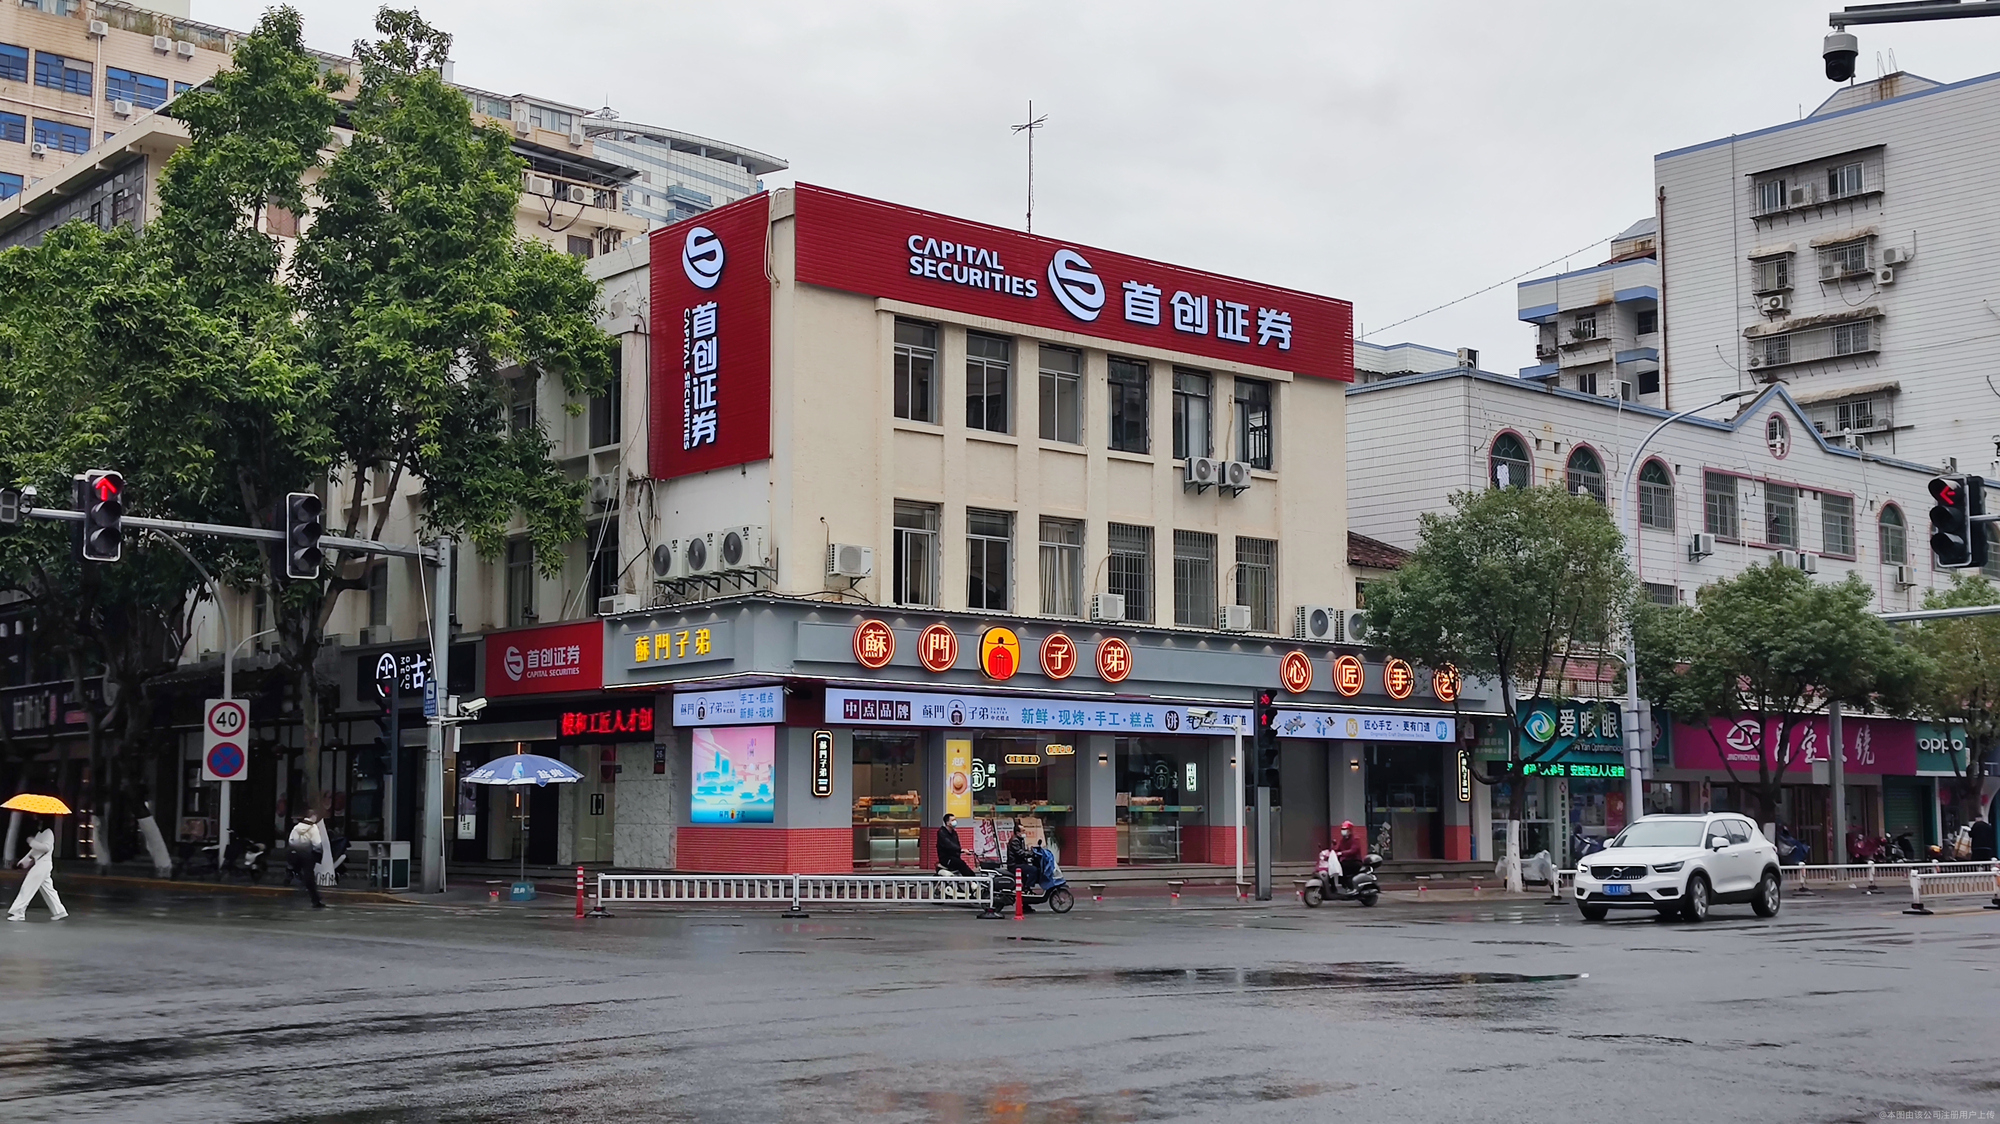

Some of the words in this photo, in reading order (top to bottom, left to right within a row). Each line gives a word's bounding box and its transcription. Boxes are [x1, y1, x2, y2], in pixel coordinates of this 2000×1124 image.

[908, 235, 1004, 270] CAPITAL
[909, 256, 1038, 297] SECURITIES
[1122, 280, 1292, 350] 首创证券
[683, 307, 691, 370] CAPITAL
[691, 301, 718, 447] 首创证券
[683, 371, 691, 450] SECURITIES
[526, 645, 580, 669] 首创证券
[635, 628, 711, 663] 蘇門子弟
[527, 669, 548, 678] CAPITAL
[549, 667, 580, 677] SECURITIES
[216, 711, 238, 728] 40
[845, 702, 910, 719] 中点品牌
[1559, 709, 1621, 739] 爱眼眼
